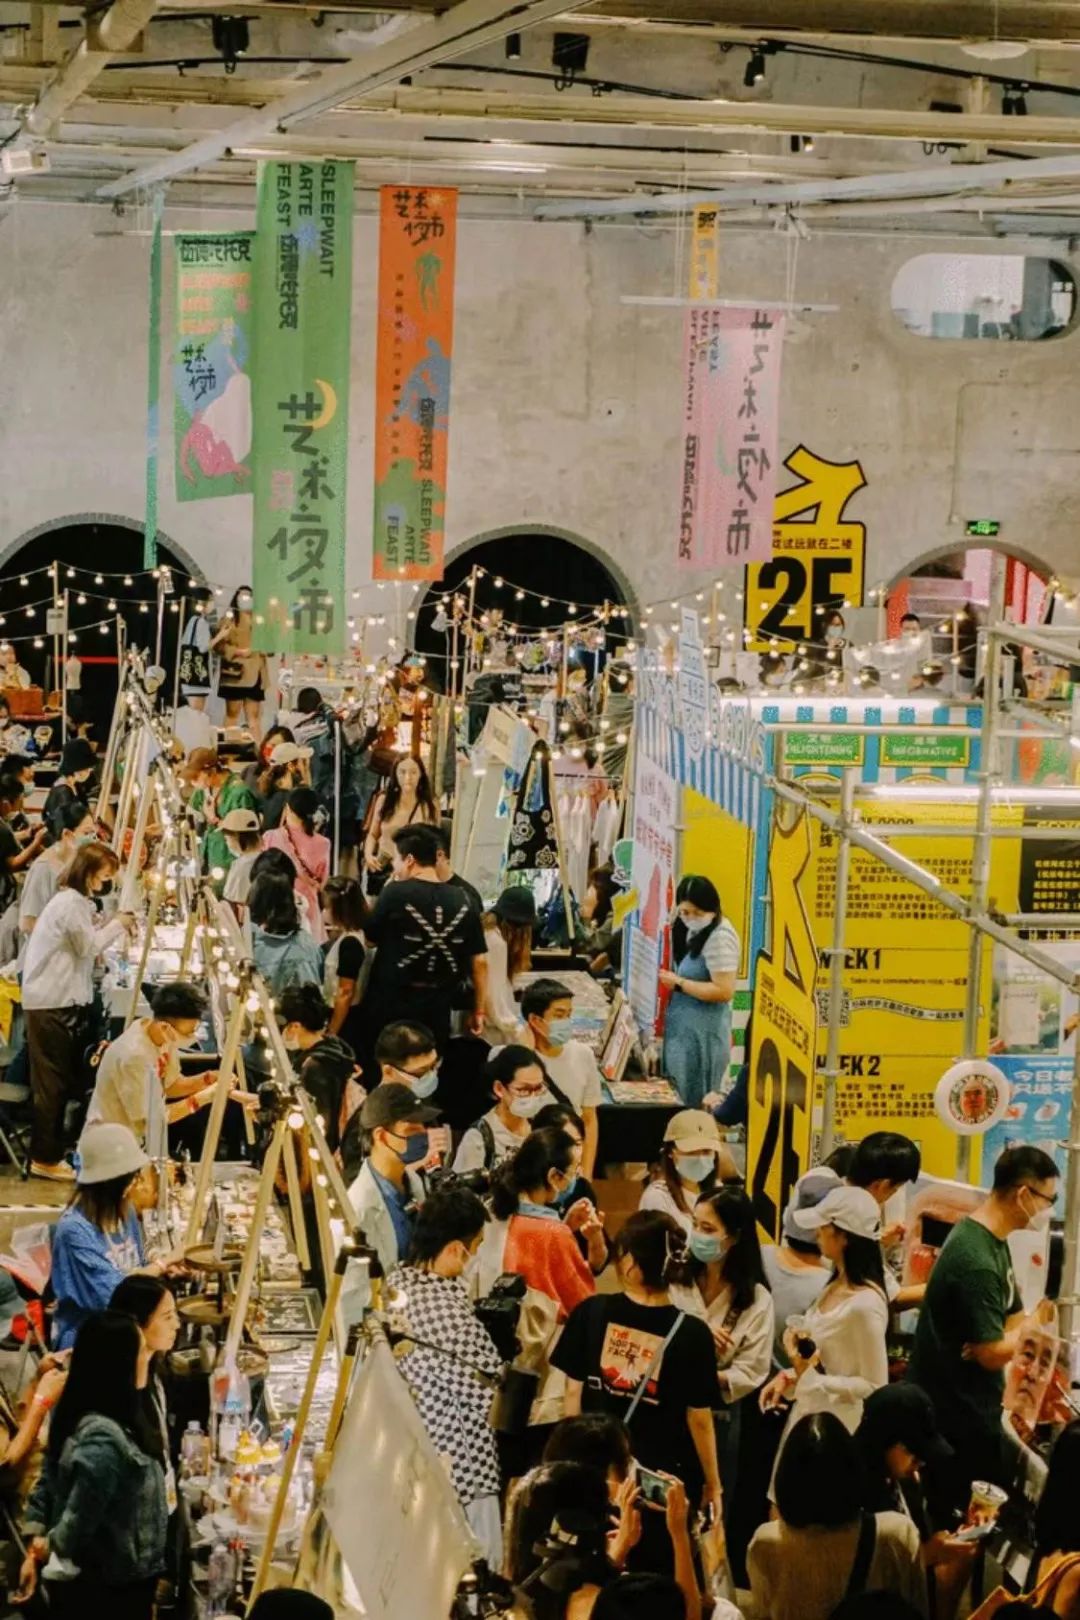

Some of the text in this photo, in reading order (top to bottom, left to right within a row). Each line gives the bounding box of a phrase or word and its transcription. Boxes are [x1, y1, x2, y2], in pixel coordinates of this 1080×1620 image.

[276, 163, 292, 227] FEAST
[298, 164, 314, 217] ARTE
[320, 165, 336, 278] SLEEPWAIT
[387, 515, 400, 565] FEAST
[404, 525, 416, 565] ARTE
[418, 478, 435, 565] SLEEPWAIT
[757, 556, 852, 640] 2F
[873, 949, 881, 970] 1
[868, 1056, 880, 1076] 2
